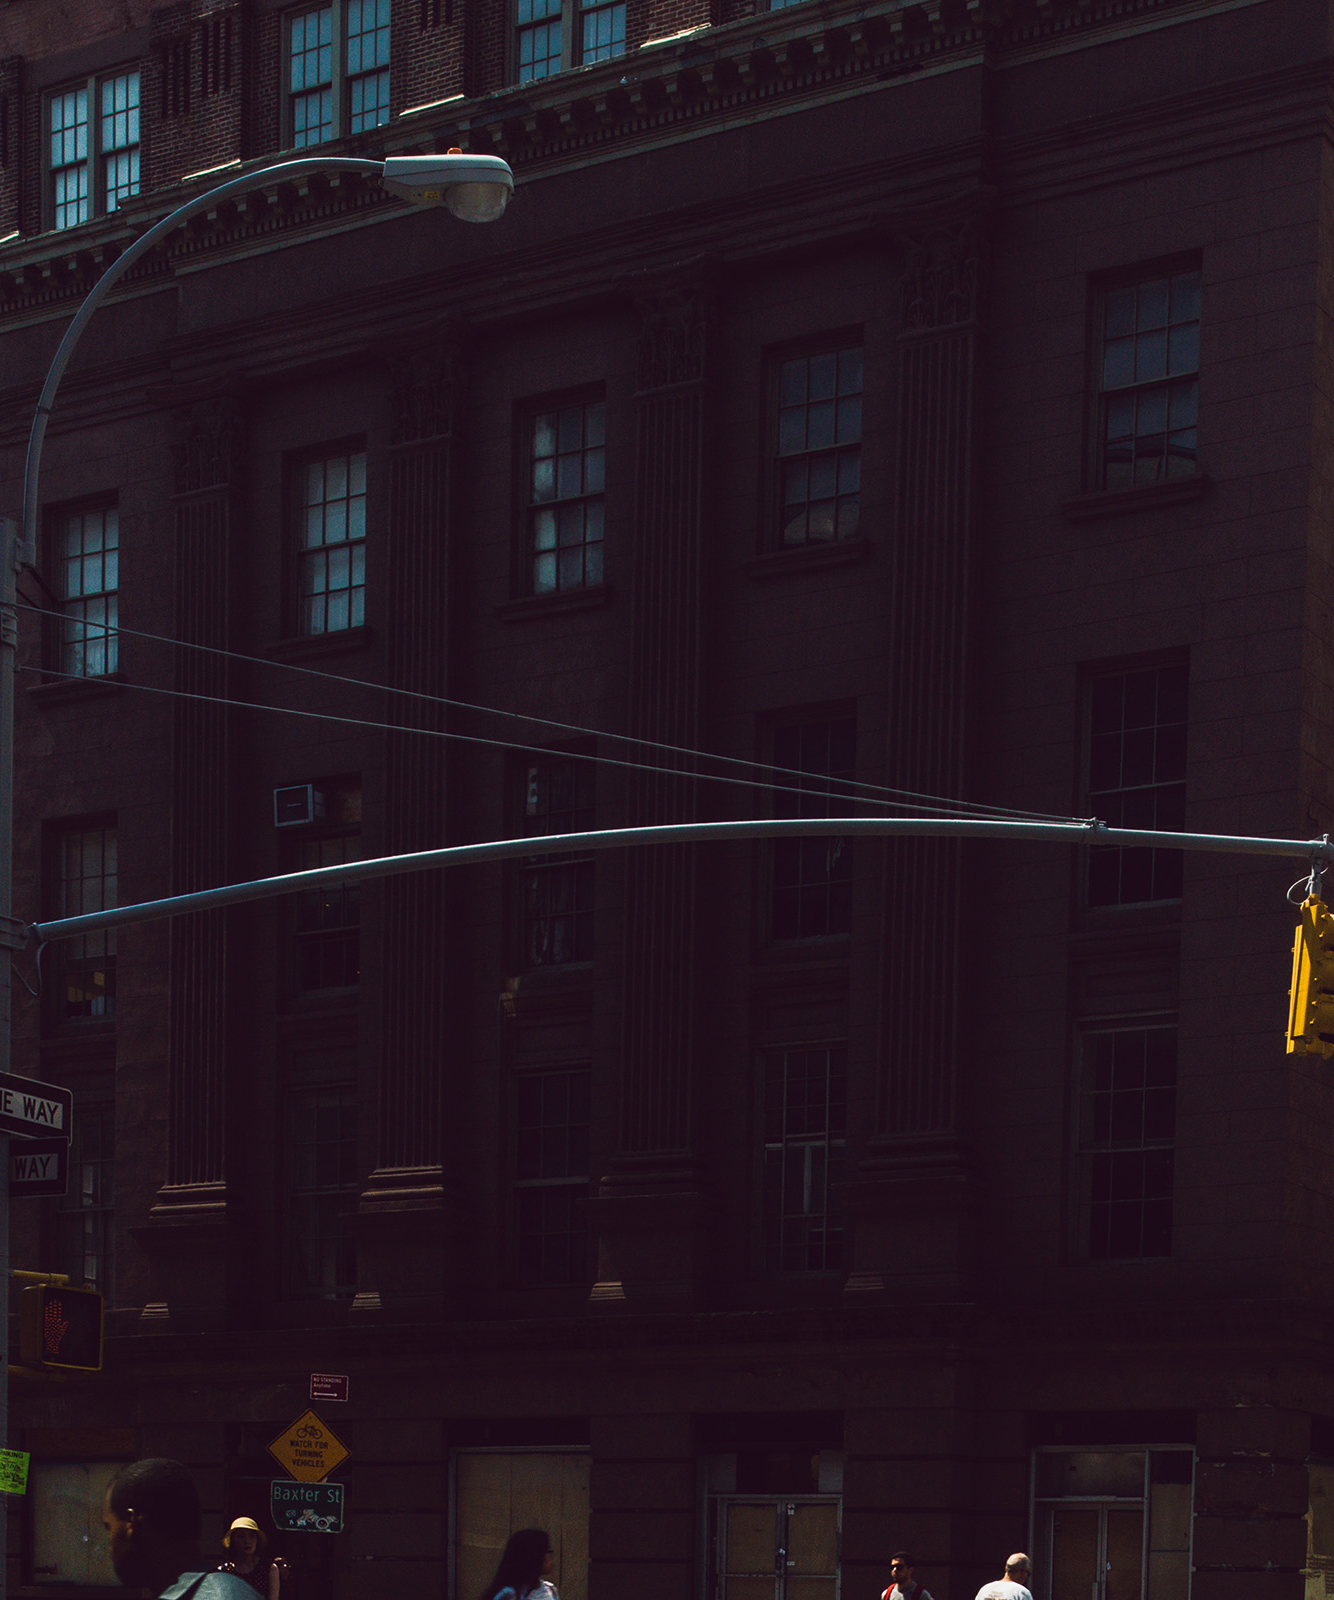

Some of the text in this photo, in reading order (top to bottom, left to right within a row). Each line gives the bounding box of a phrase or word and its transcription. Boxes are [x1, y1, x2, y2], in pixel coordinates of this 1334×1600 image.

[23, 1098, 58, 1124] WAY
[14, 1156, 51, 1179] WAY
[290, 1440, 328, 1449] WATCH FOR
[295, 1449, 324, 1458] TURNING
[292, 1459, 325, 1468] VEHICLES
[274, 1486, 339, 1504] Baxter St
